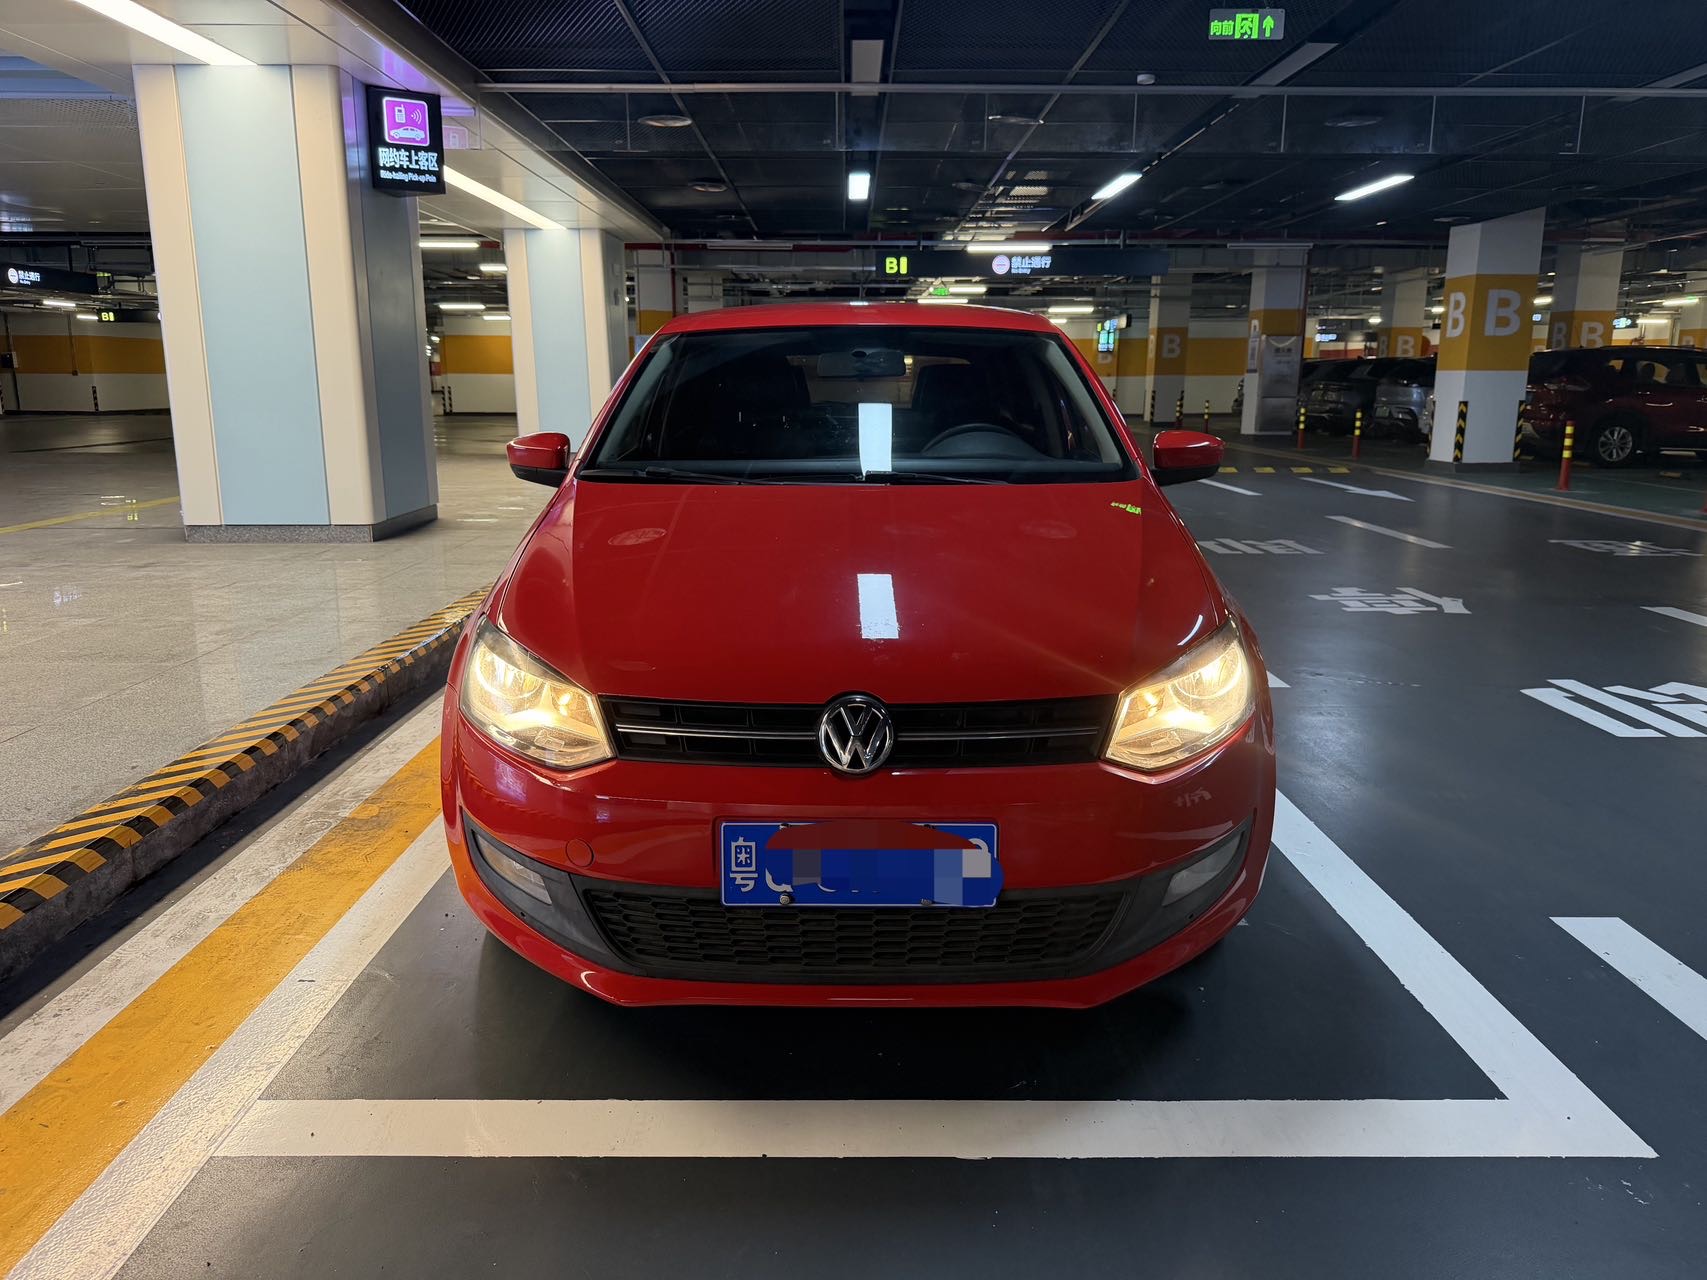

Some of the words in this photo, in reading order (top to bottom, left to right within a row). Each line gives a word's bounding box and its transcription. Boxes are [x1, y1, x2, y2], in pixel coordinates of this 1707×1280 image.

[1210, 20, 1234, 35] 向前
[378, 147, 439, 170] 网约车上客区
[1447, 292, 1466, 337] B
[1484, 289, 1520, 336] B
[1162, 334, 1181, 358] B
[1397, 335, 1415, 357] B
[1580, 321, 1604, 348] B
